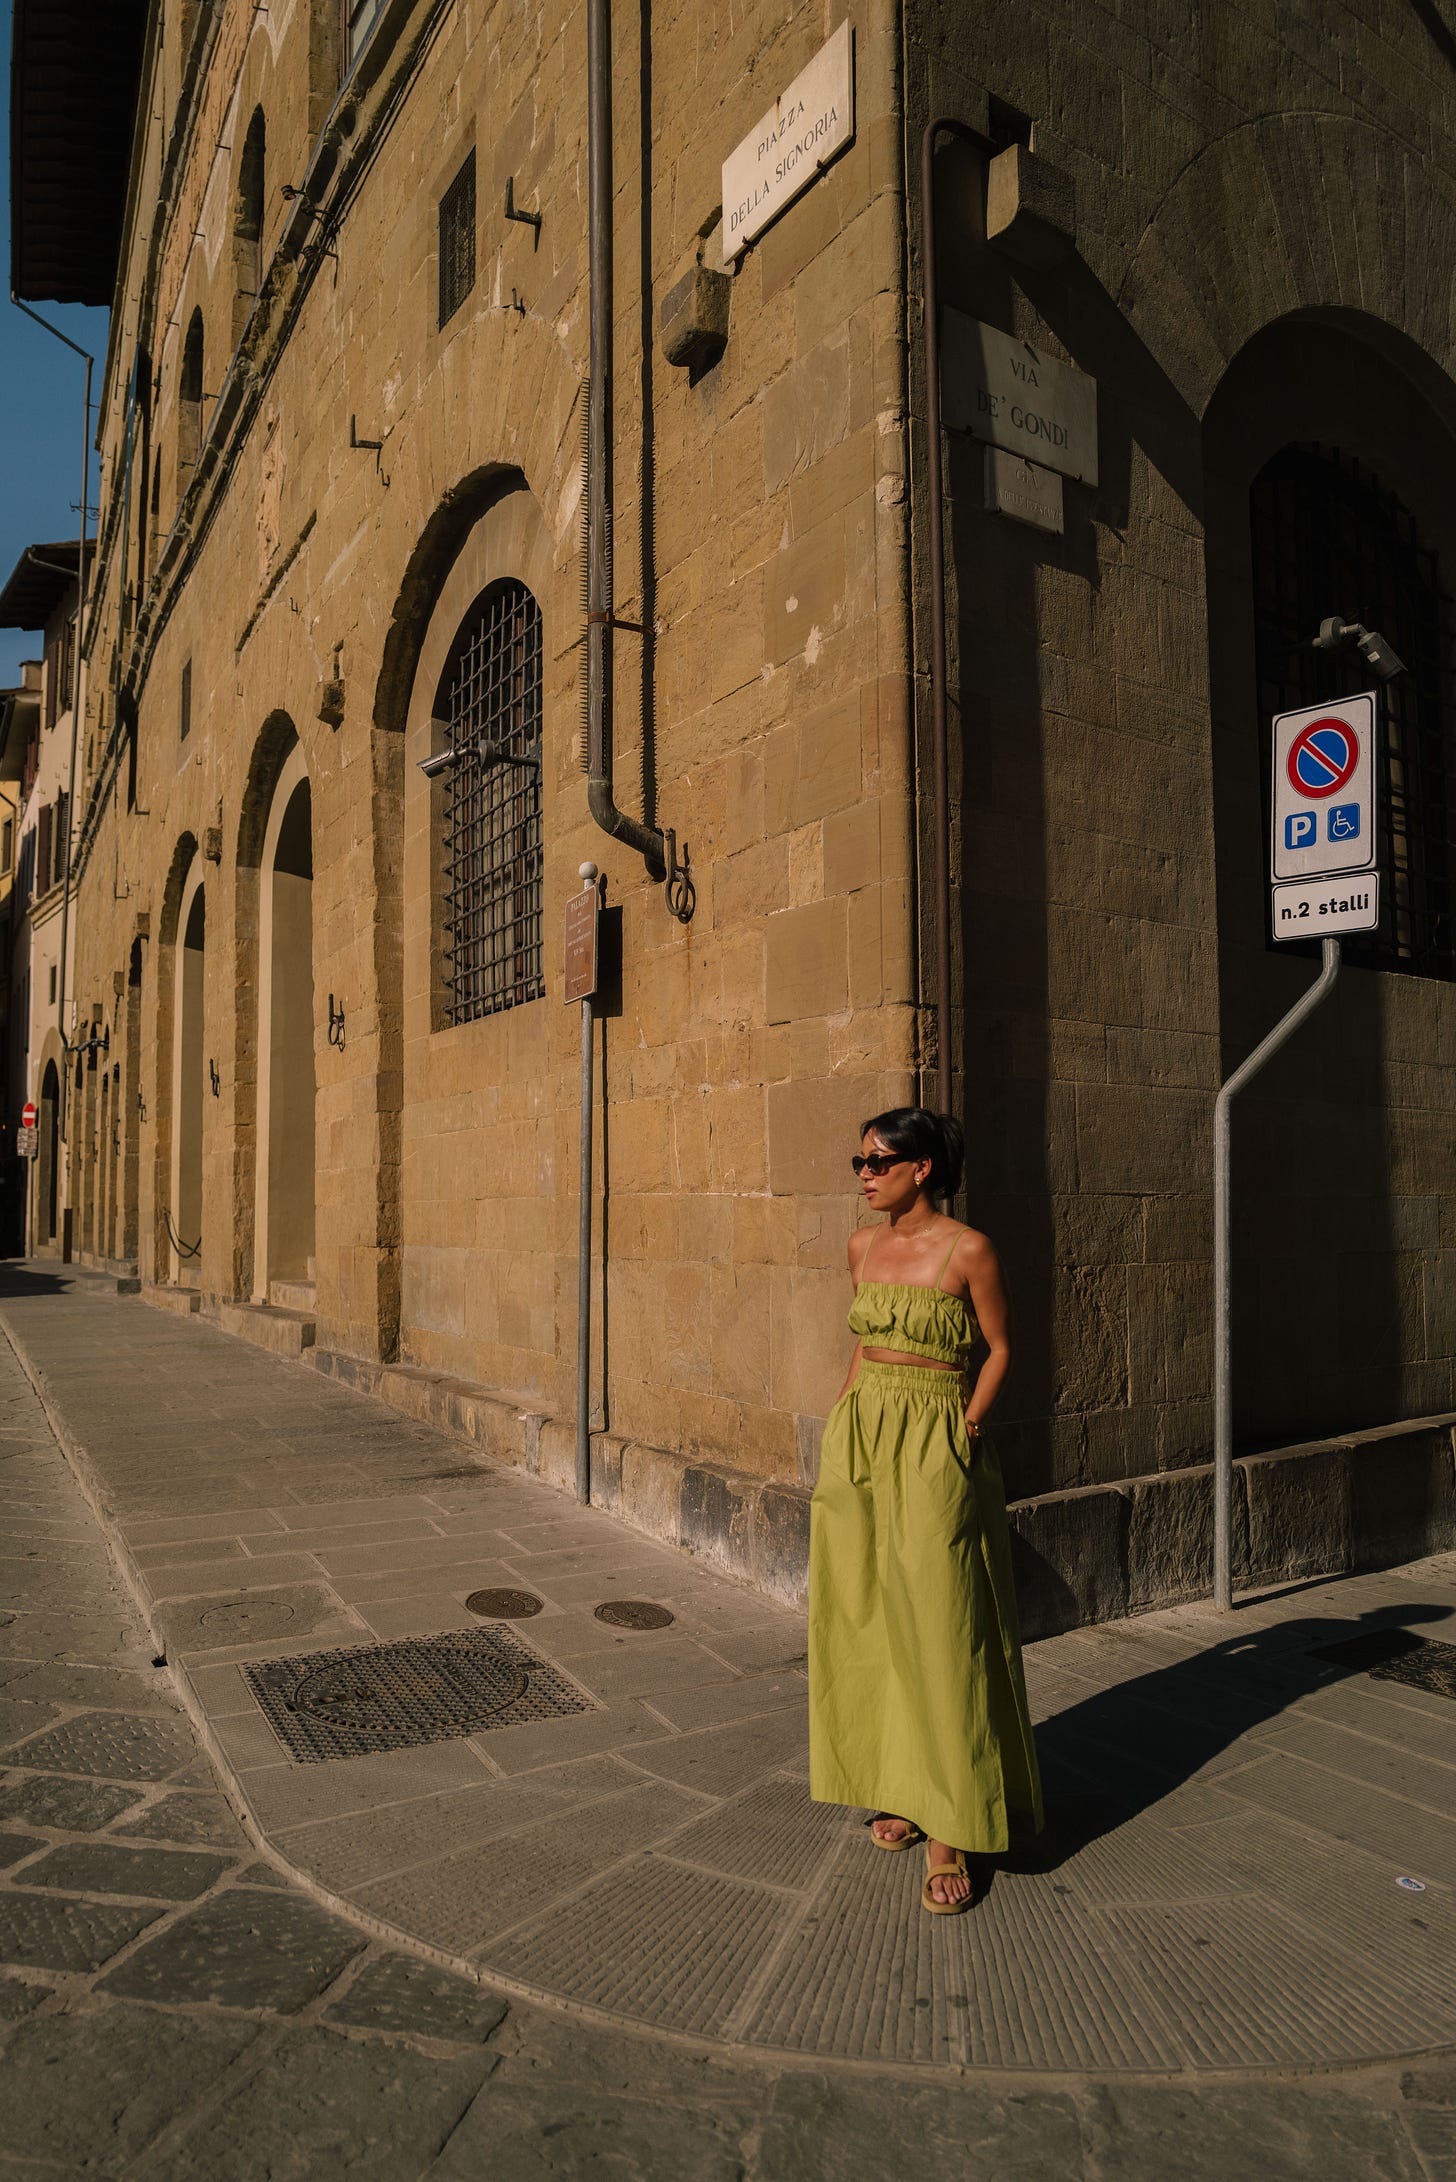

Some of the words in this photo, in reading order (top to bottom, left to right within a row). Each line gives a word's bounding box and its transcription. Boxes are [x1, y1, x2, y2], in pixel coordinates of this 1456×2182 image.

[757, 100, 805, 161] PIAZZA
[730, 179, 770, 232] DELLA
[775, 106, 838, 183] SIGNORIA
[1010, 358, 1040, 388] VIA
[1010, 406, 1069, 450] GONDI
[1291, 815, 1312, 846] P
[1281, 902, 1310, 920] n.2
[1318, 893, 1369, 915] stalli
